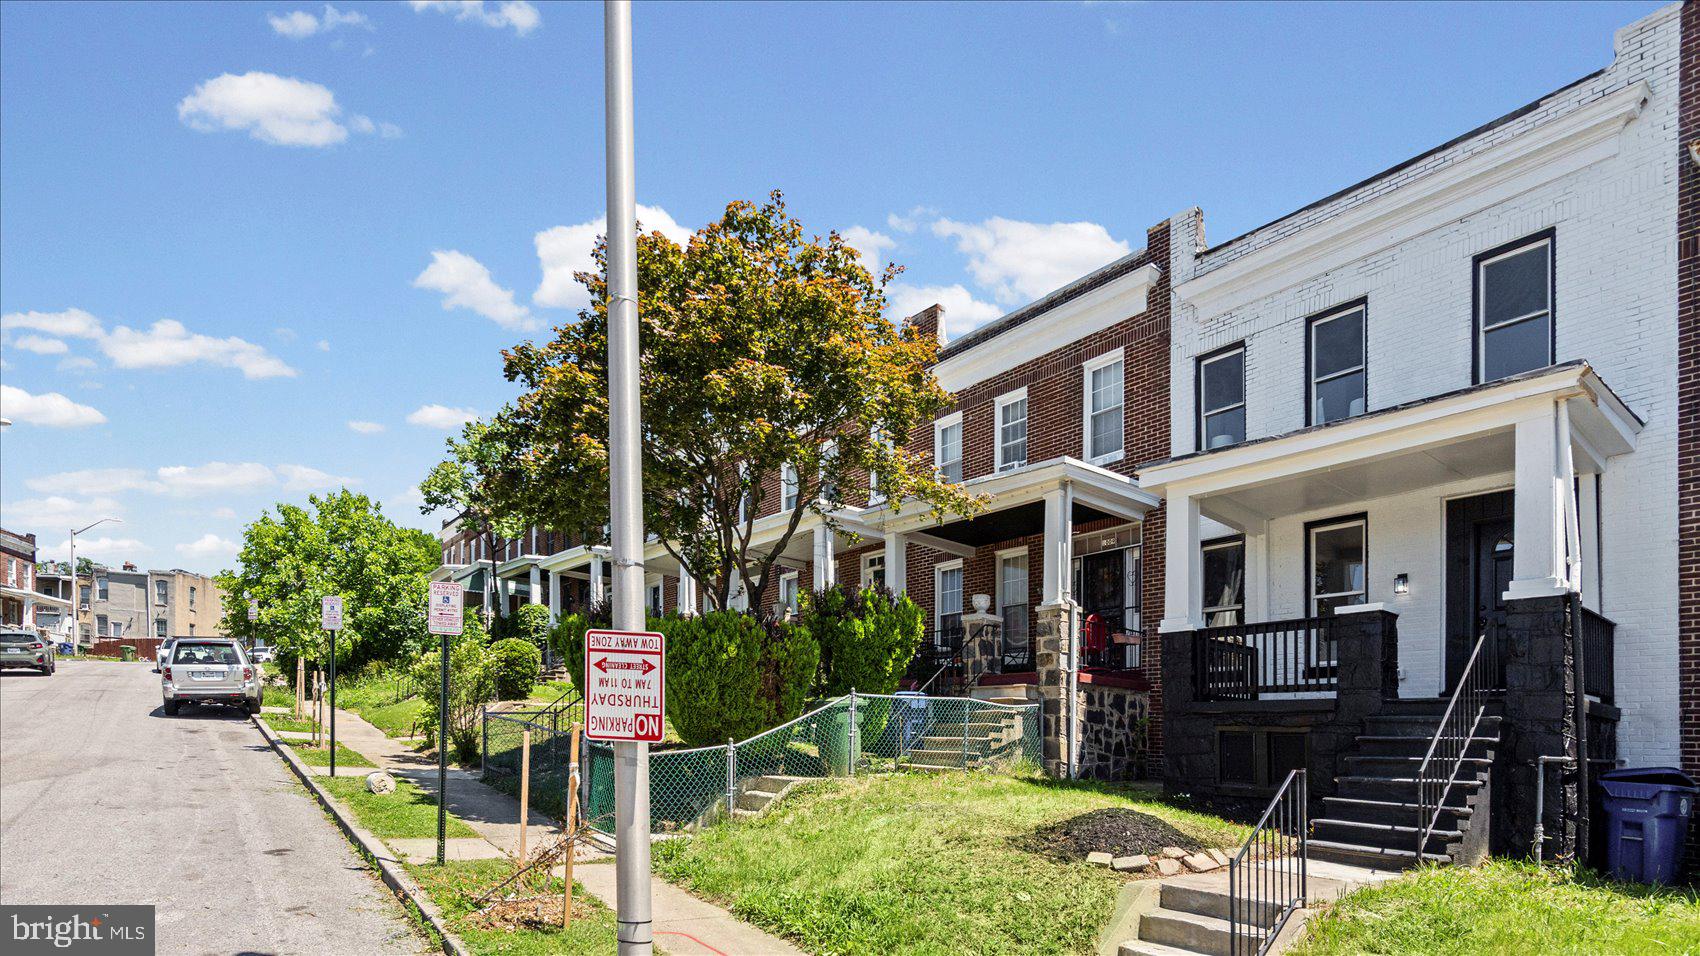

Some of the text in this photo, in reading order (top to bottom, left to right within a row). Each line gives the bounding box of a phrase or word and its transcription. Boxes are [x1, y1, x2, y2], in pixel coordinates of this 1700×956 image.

[591, 635, 659, 650] TOW AWAY ZONE
[601, 661, 649, 671] STREET CLEANING
[598, 677, 652, 690] 7AM TO 11AM
[591, 693, 659, 709] THURSDAY
[591, 715, 659, 736] NO PARKING
